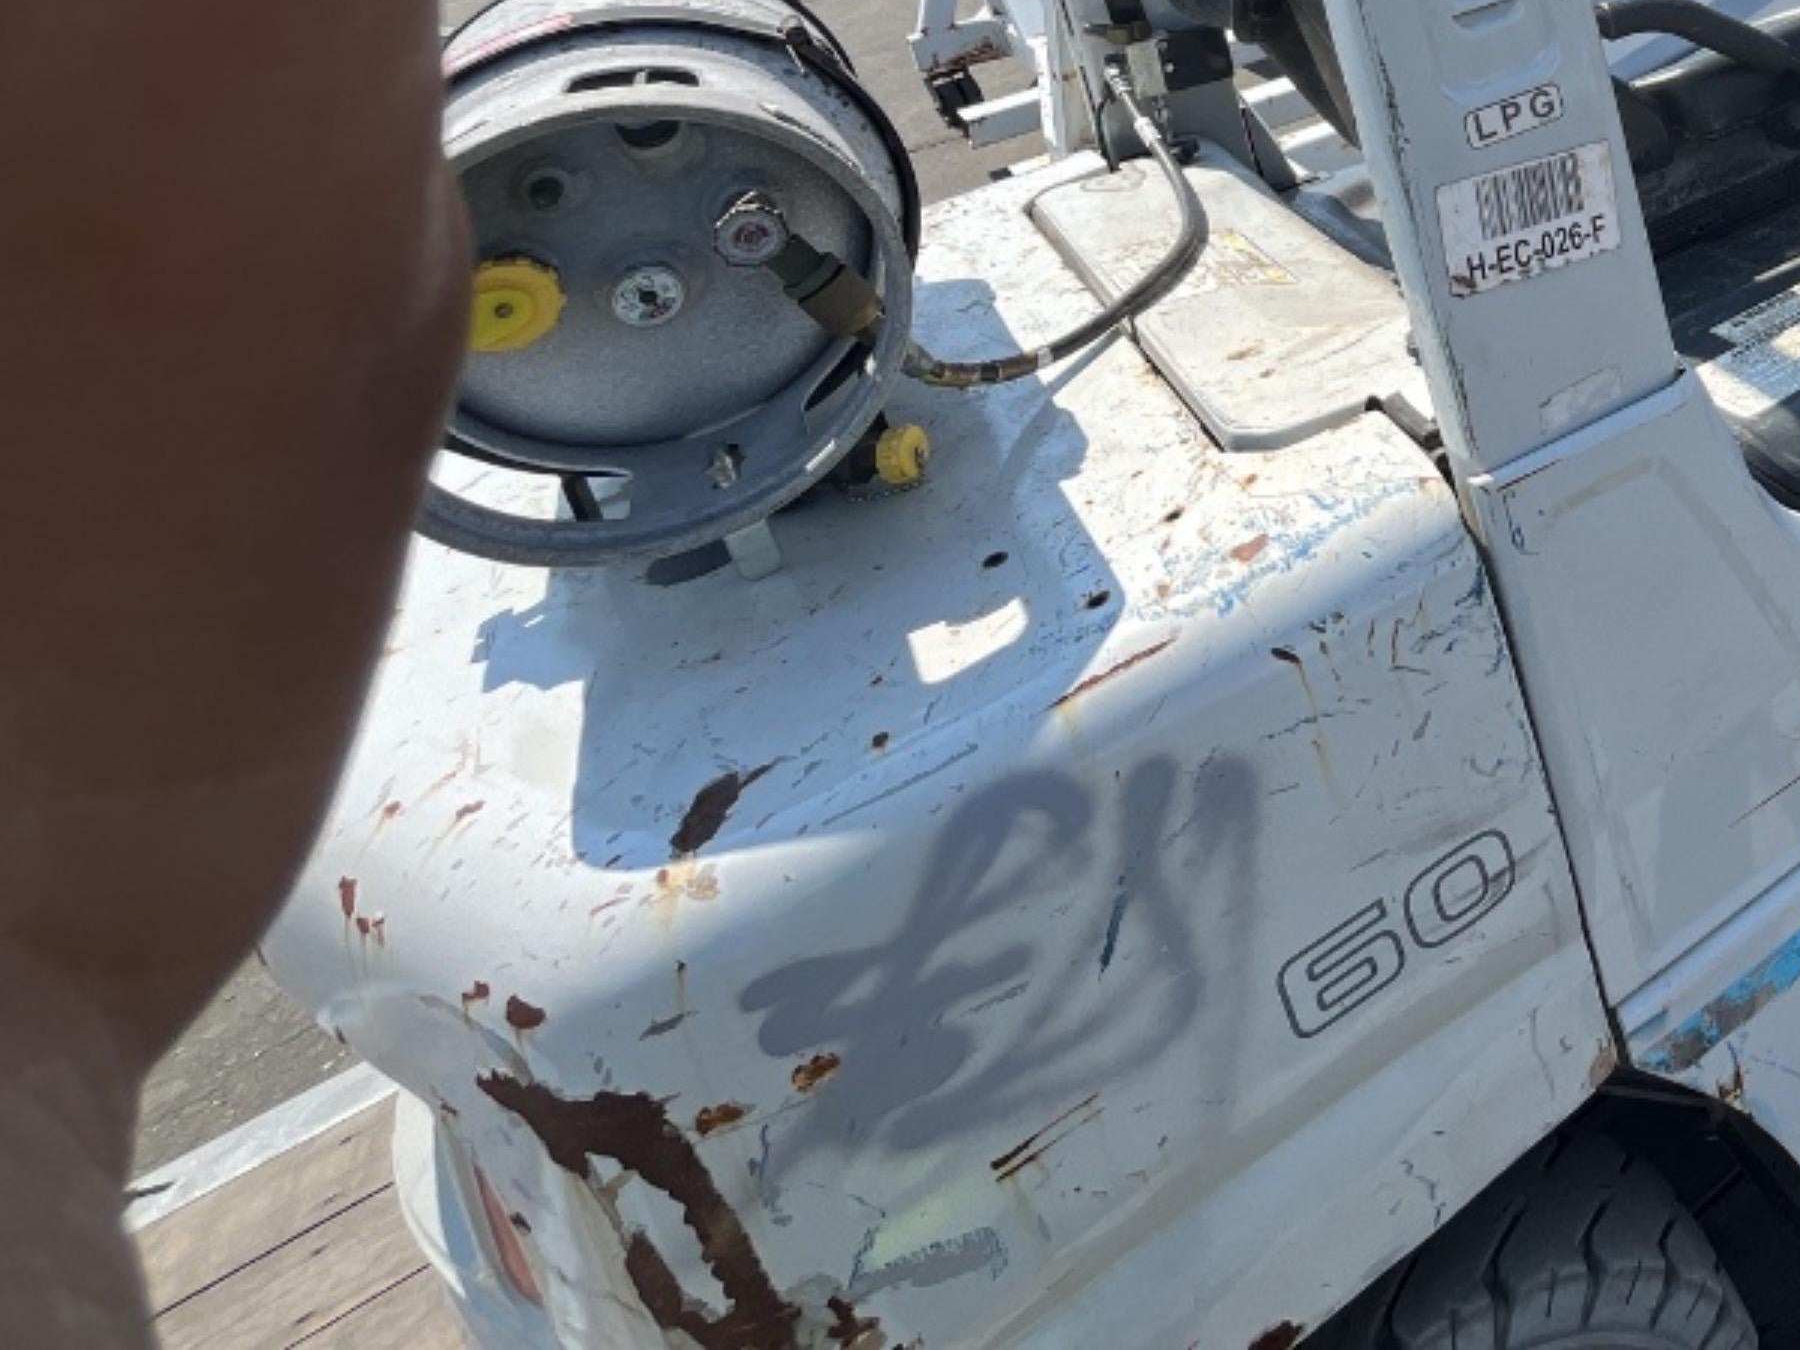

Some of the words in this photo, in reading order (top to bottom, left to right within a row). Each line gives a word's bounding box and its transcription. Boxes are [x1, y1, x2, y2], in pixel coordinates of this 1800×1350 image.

[1473, 90, 1556, 142] LPG
[1466, 213, 1606, 280] H-EC-026-F
[1277, 828, 1515, 1038] 60
